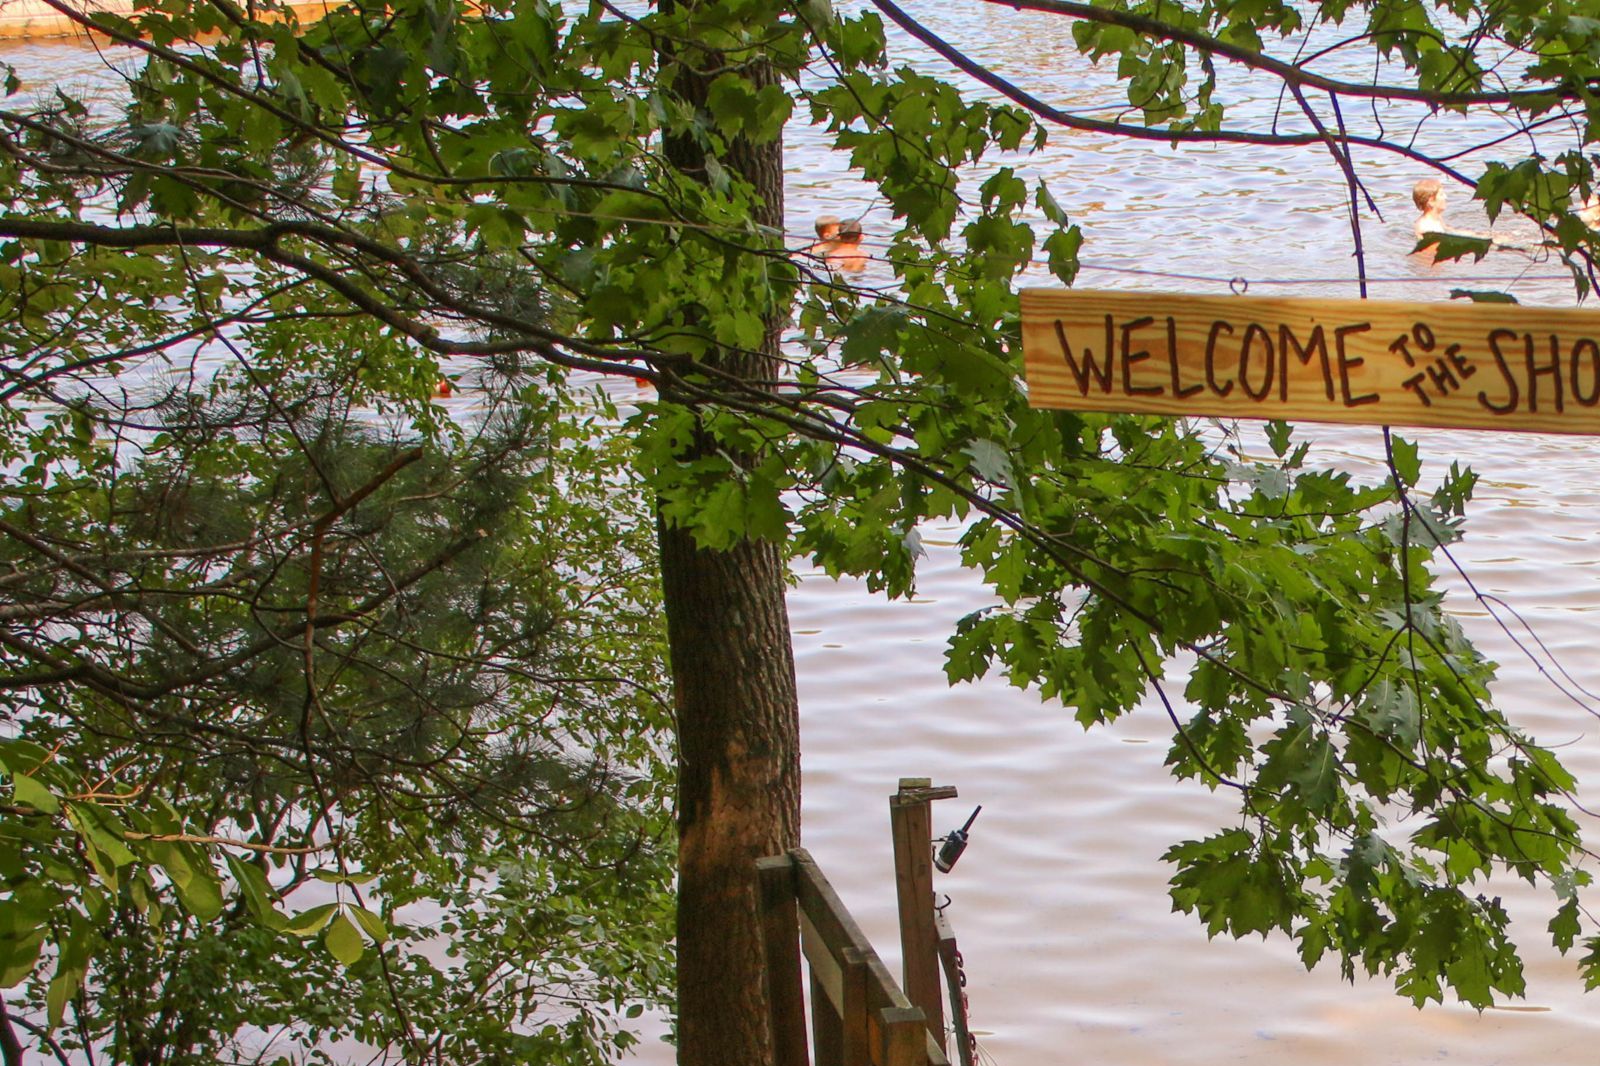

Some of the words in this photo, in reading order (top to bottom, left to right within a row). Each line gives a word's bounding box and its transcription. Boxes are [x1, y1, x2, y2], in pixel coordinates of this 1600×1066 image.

[1053, 314, 1381, 407] WELCOME
[1387, 321, 1436, 368] TO
[1400, 342, 1478, 408] THE
